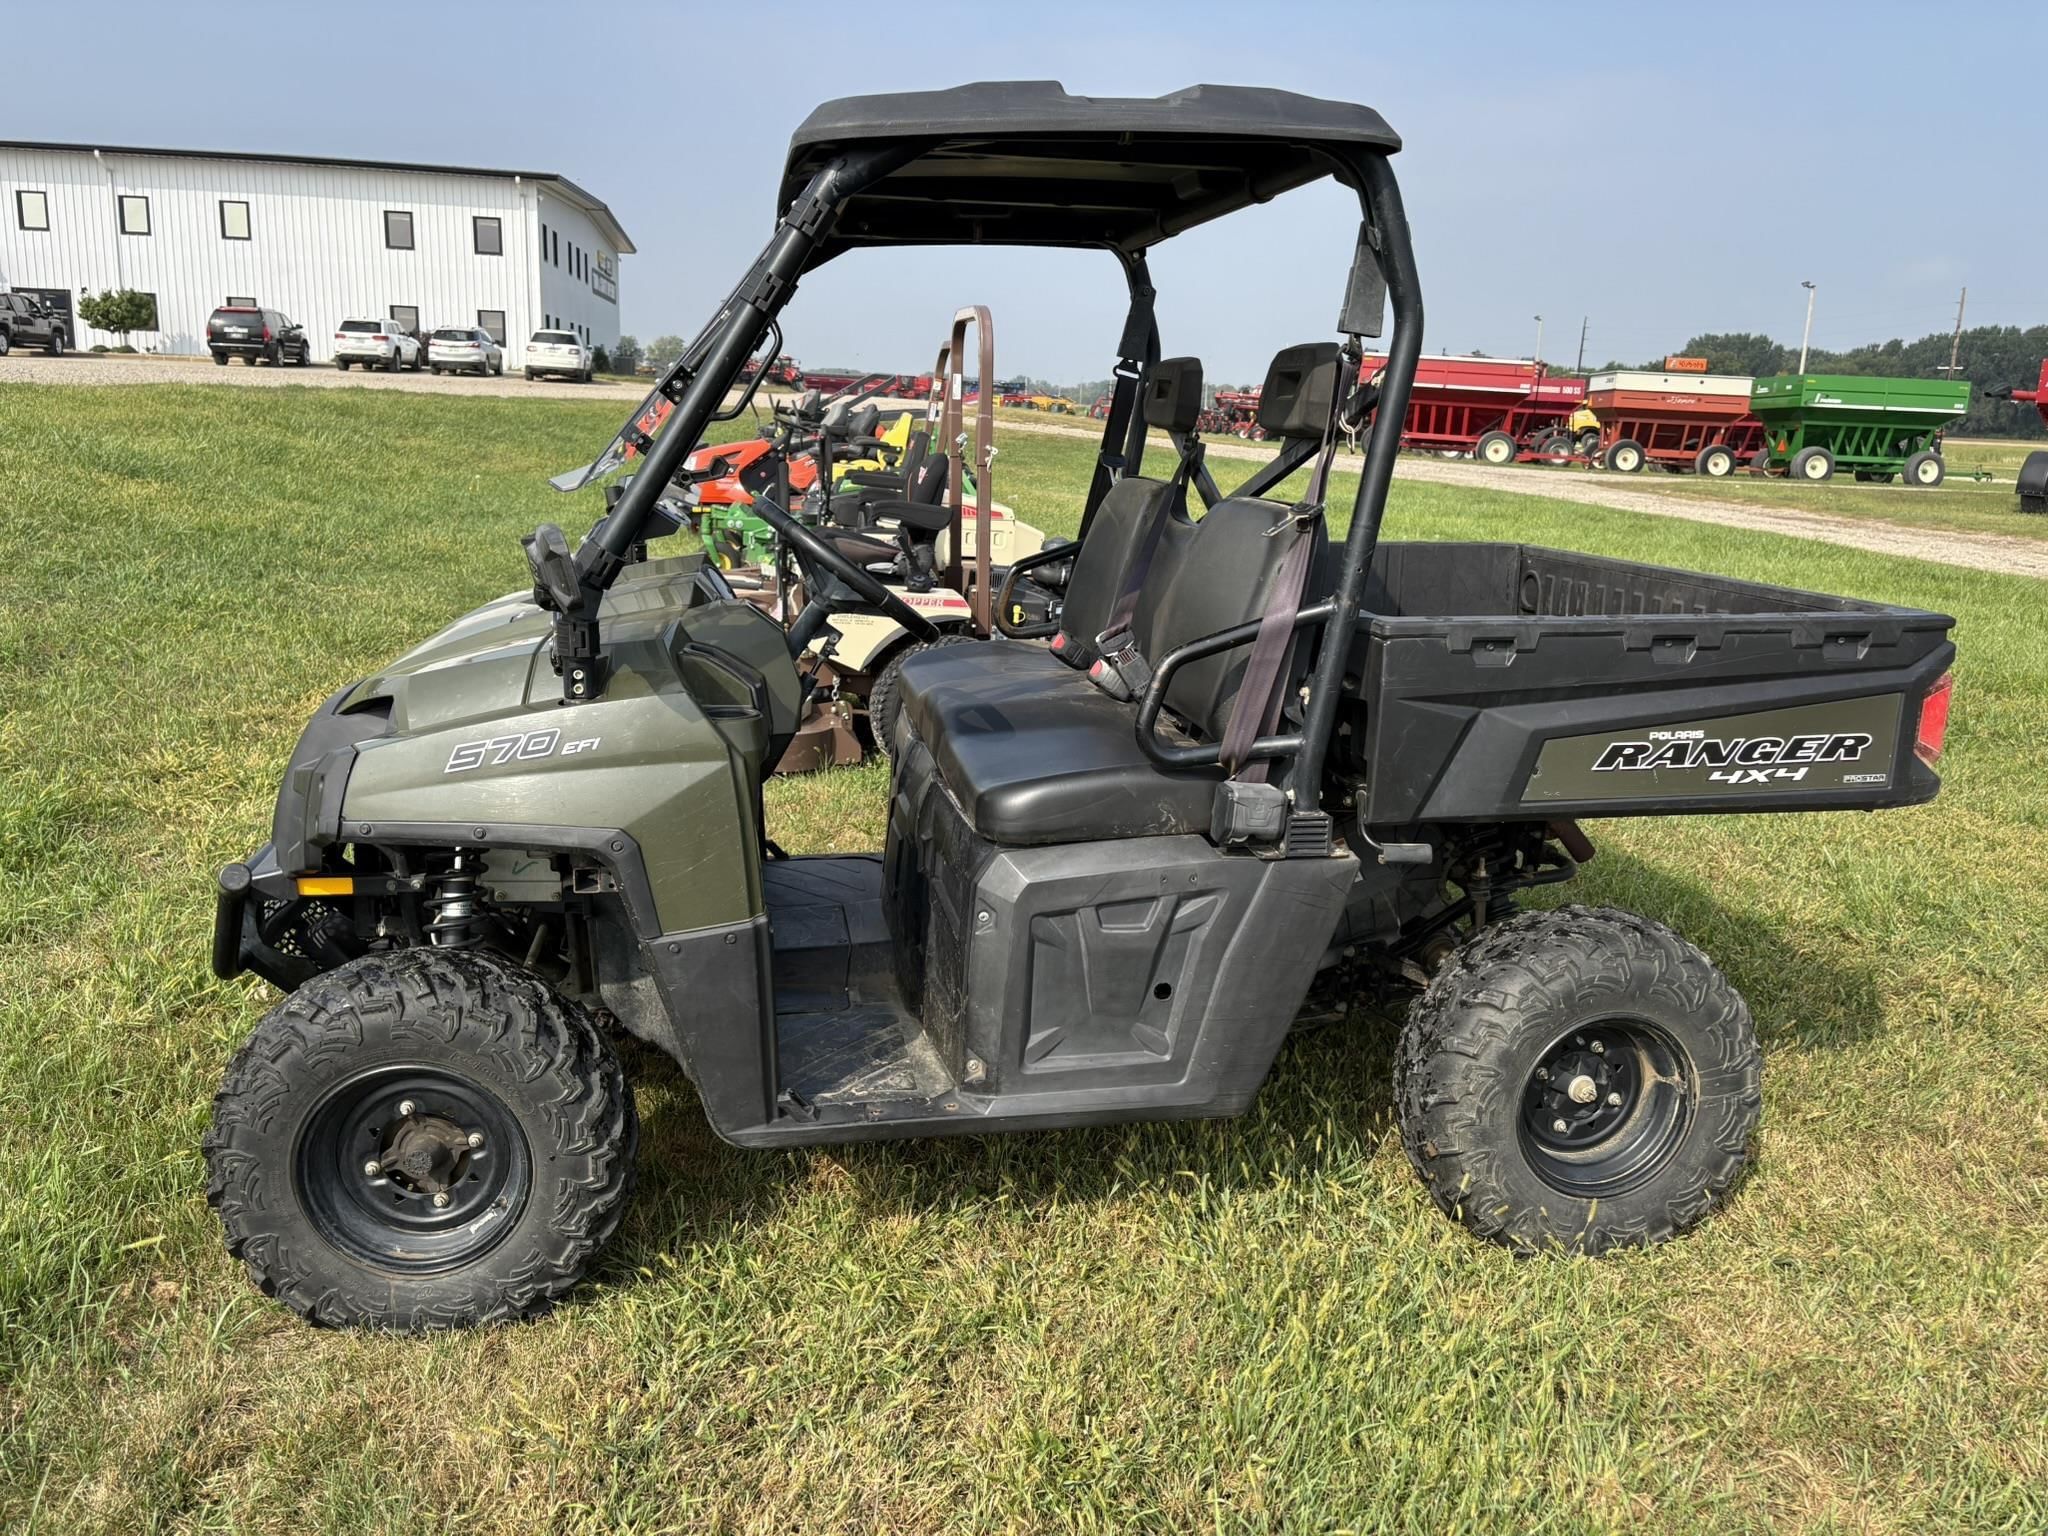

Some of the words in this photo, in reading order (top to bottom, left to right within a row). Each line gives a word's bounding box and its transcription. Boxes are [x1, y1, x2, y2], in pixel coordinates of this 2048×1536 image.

[444, 728, 560, 773] 570
[561, 737, 600, 755] EFI
[1591, 733, 1872, 771] RANGER
[1649, 730, 1704, 741] POLARIS
